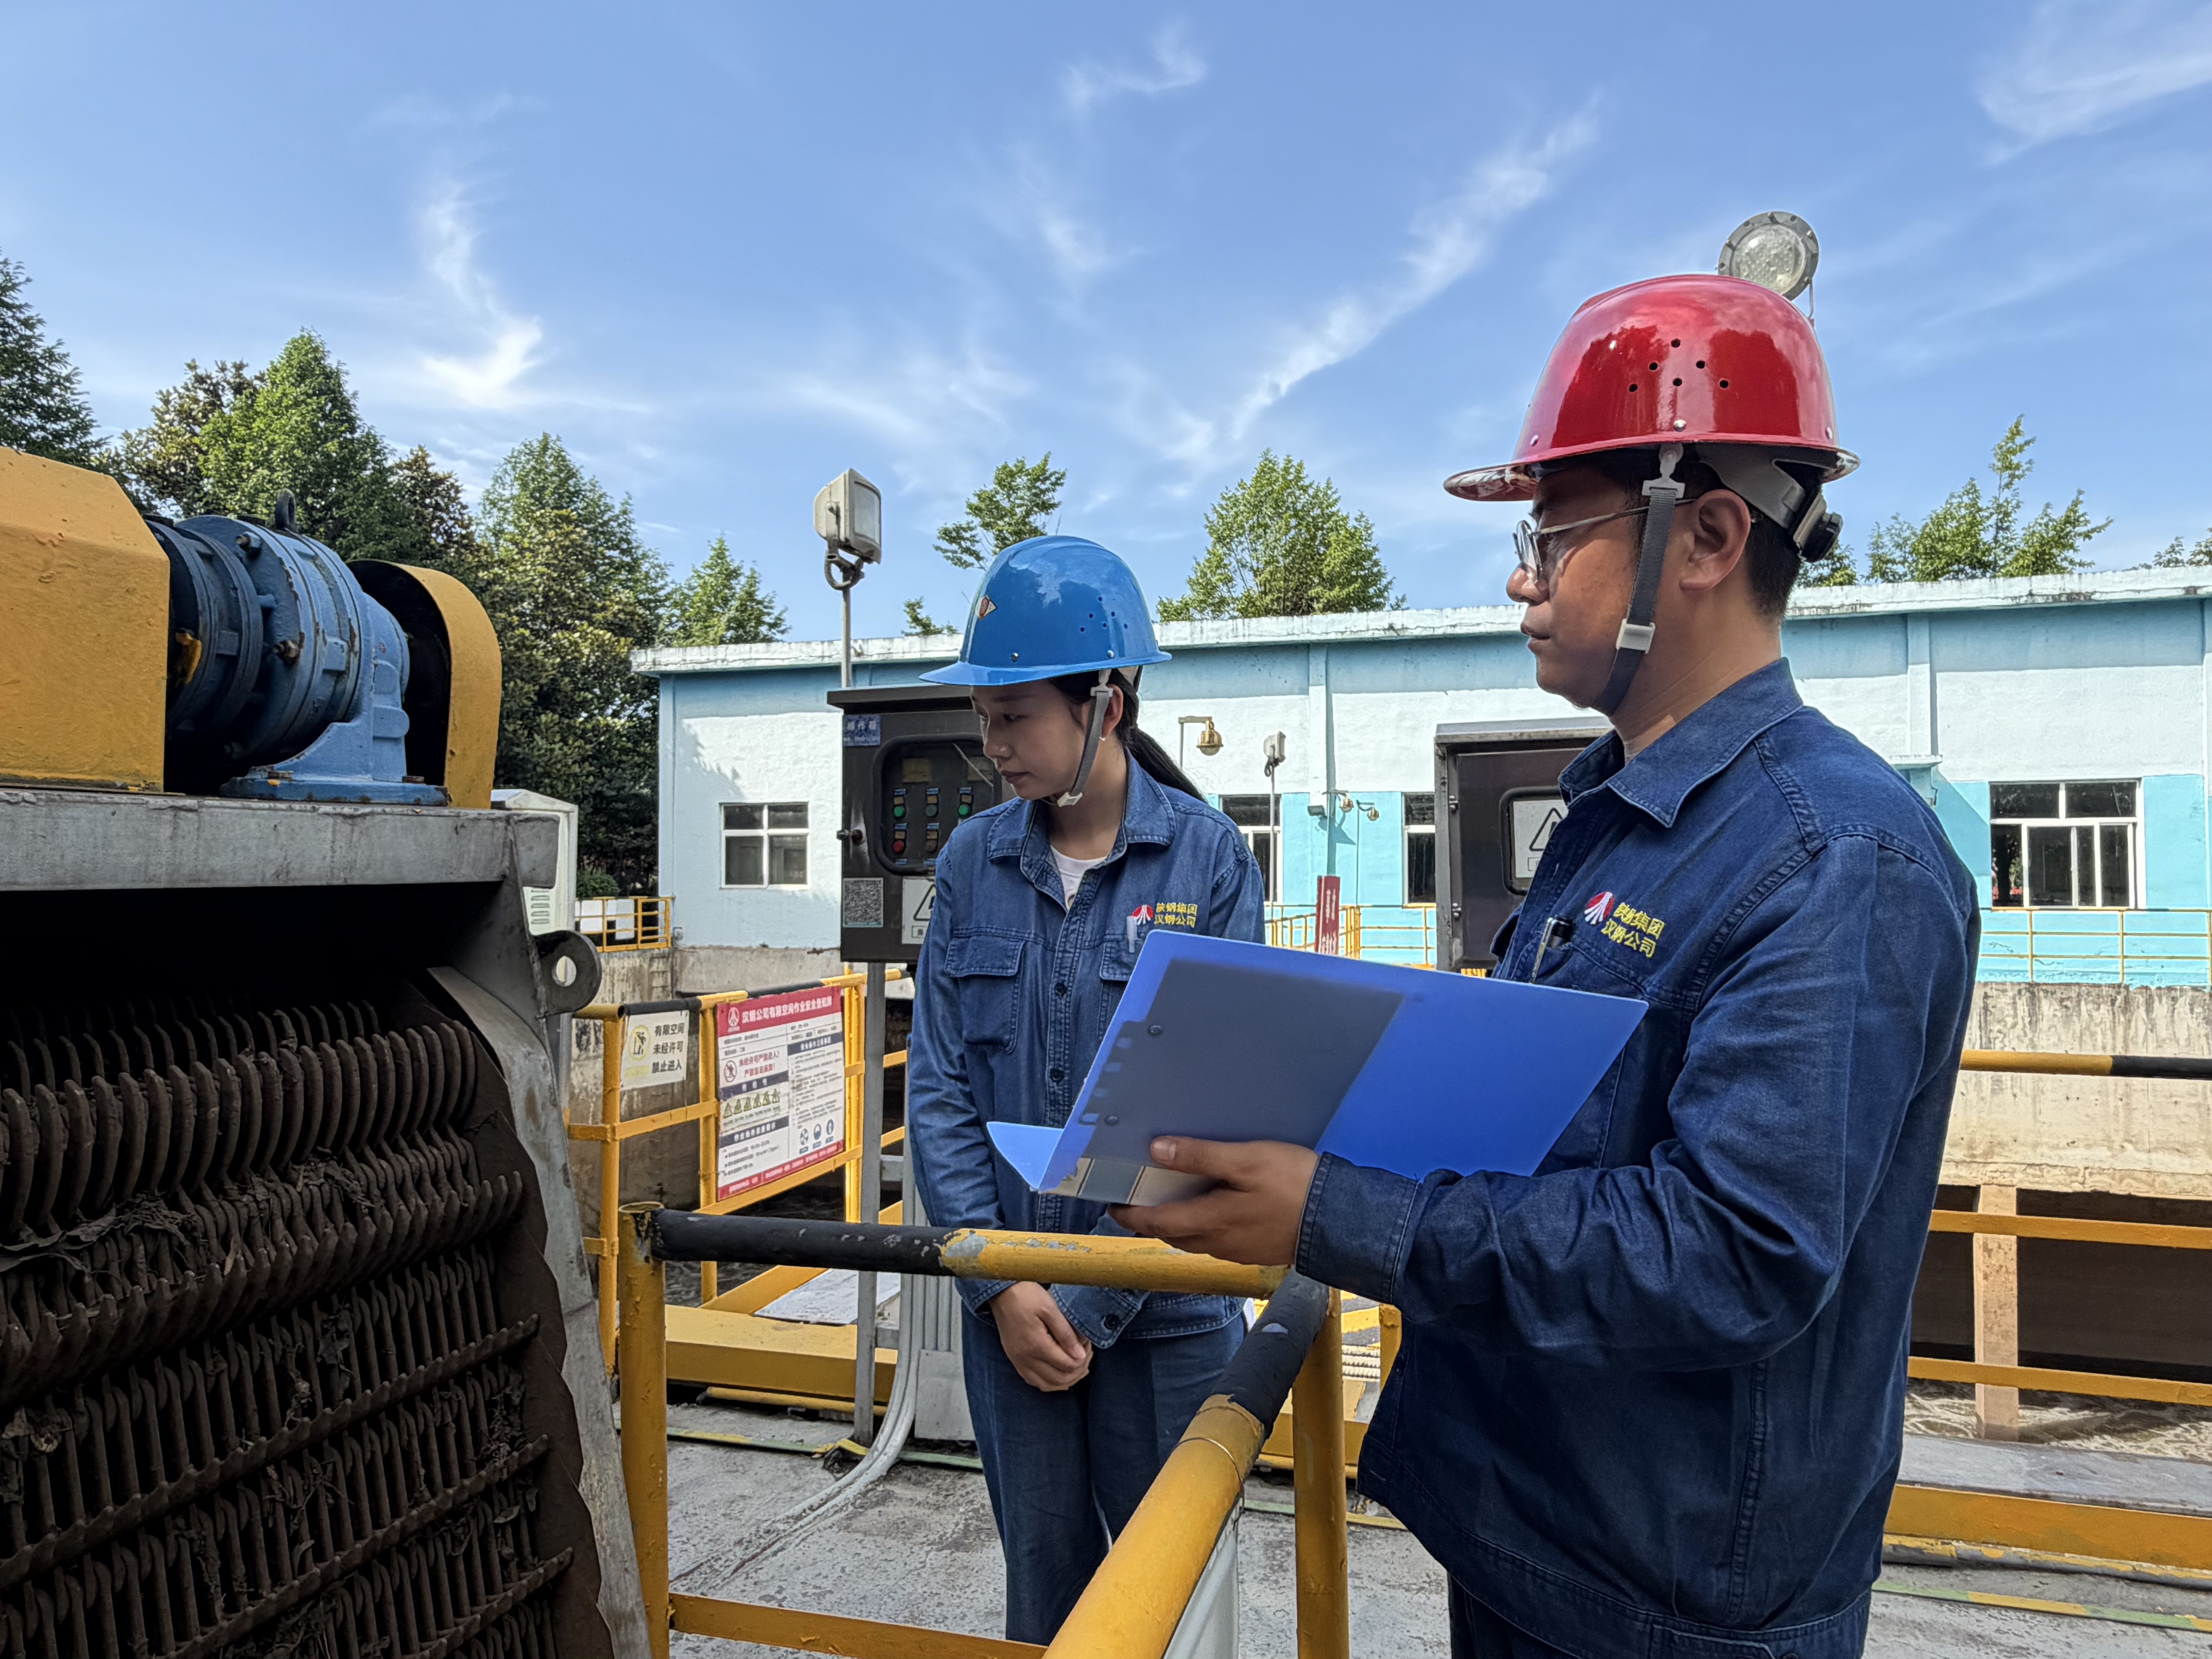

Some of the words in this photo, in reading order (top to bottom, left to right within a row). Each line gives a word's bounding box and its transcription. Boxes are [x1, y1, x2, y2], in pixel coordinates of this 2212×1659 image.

[1156, 902, 1198, 916] 陕钢集团
[1154, 914, 1196, 928] 汉钢公司
[1613, 902, 1665, 940] 陕钢集团
[1601, 918, 1656, 958] 汉钢公司
[654, 1022, 685, 1037] 有限空间
[652, 1041, 684, 1054] 未经许可
[651, 1059, 682, 1073] 禁止进入
